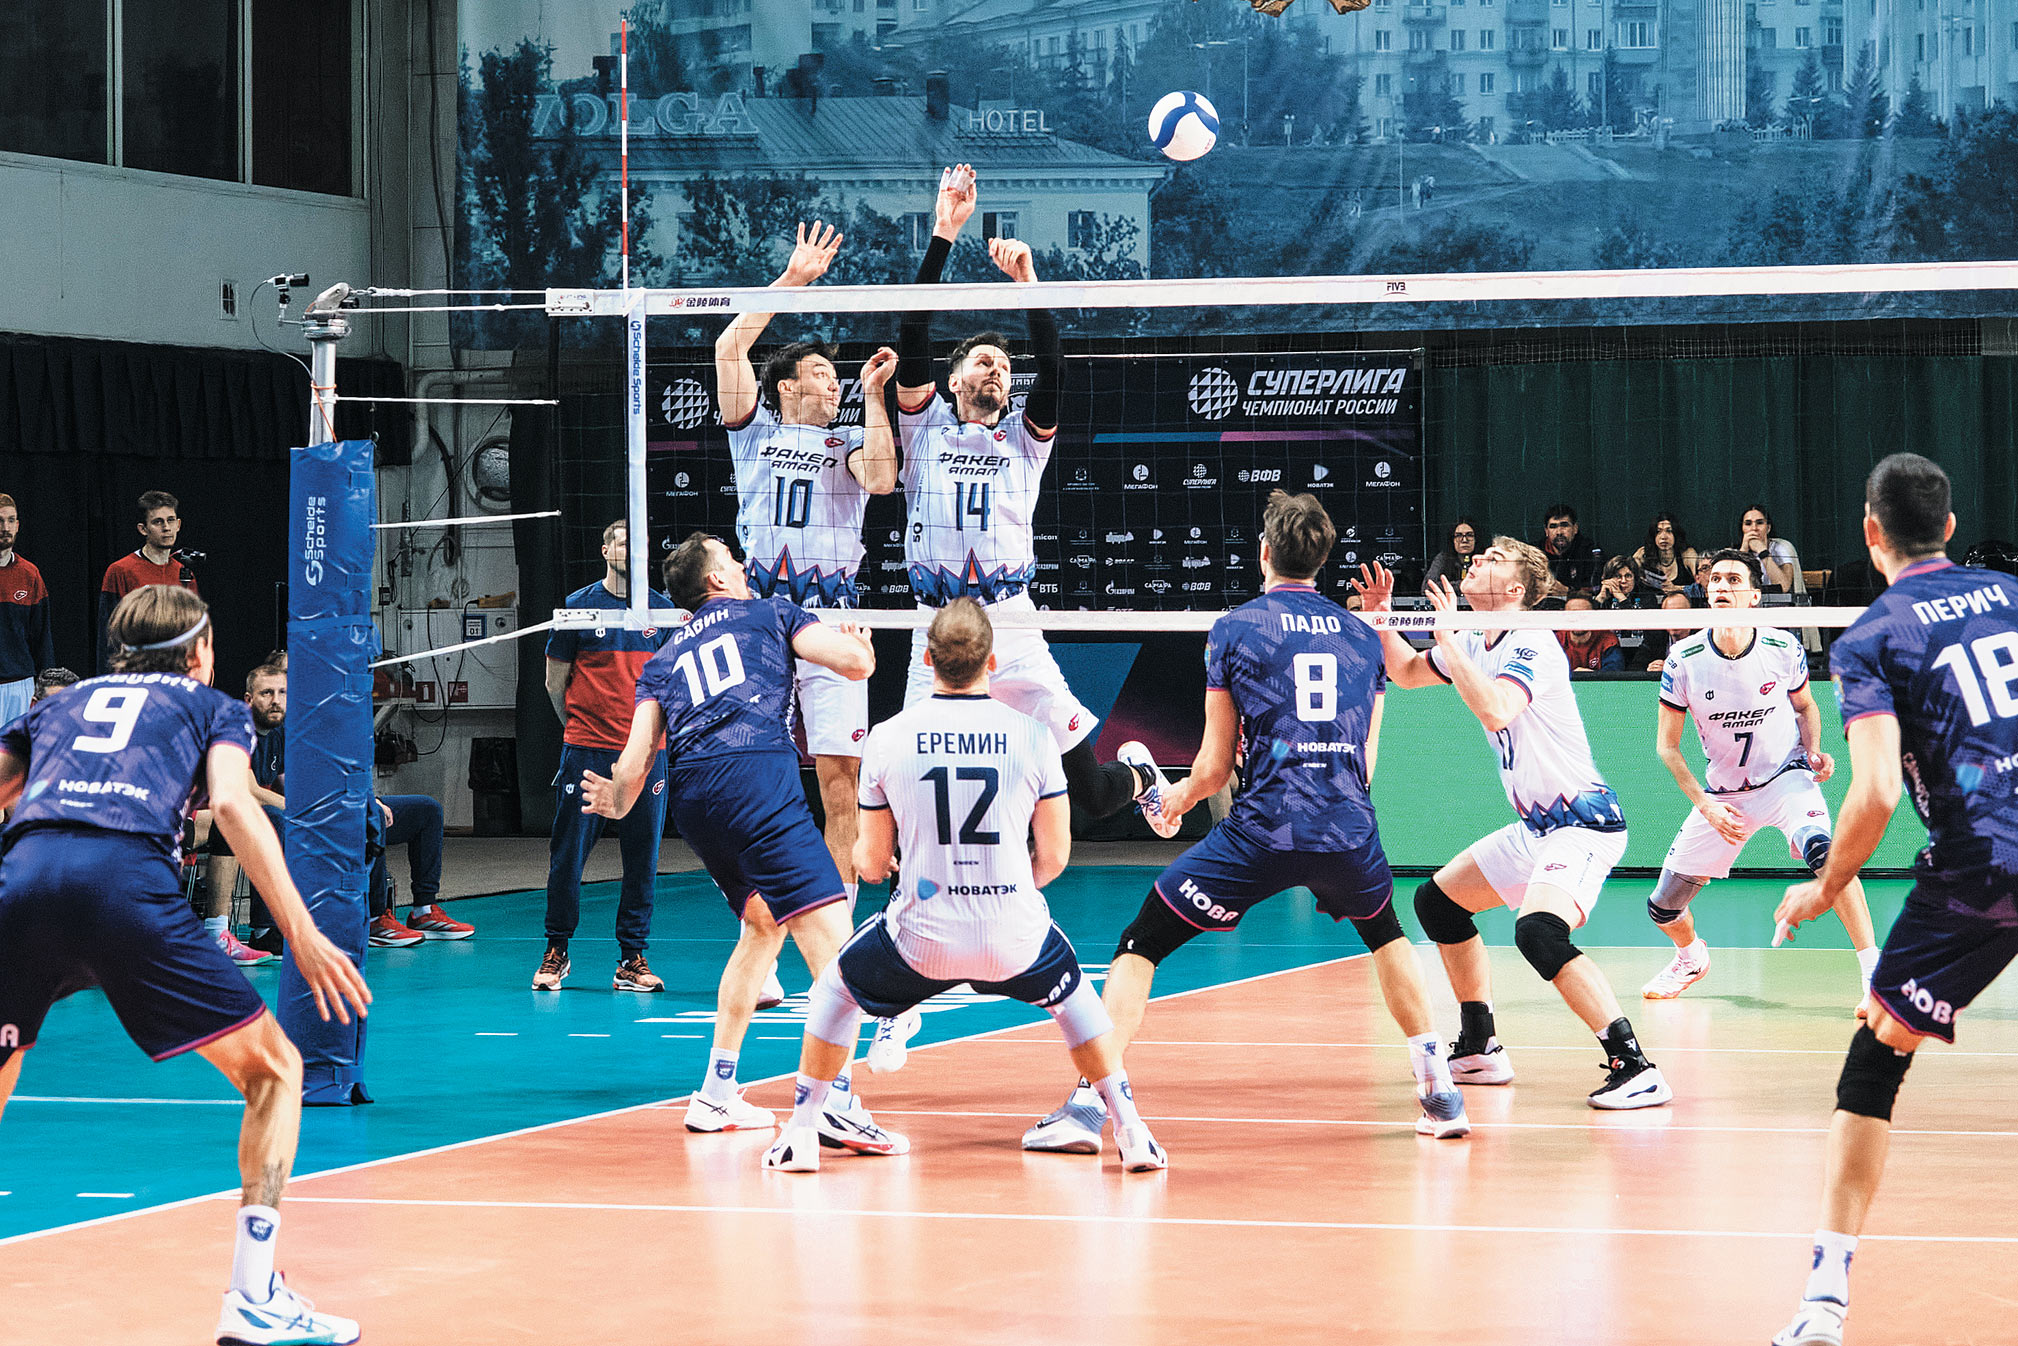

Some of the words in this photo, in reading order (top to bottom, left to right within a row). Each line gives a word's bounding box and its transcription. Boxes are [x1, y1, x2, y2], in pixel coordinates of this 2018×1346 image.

[969, 109, 1052, 132] HOTEL
[632, 331, 641, 376] Schelde
[631, 377, 641, 415] Sports
[1247, 368, 1407, 395] СУПЕРЛИГА
[1242, 400, 1334, 416] ЧЕМПИОНАТ
[1335, 399, 1398, 415] РОССИИ
[1250, 469, 1281, 482] ВФВ
[774, 476, 814, 529] 10
[955, 482, 990, 532] 14
[304, 496, 316, 560] Schelde
[313, 496, 327, 560] Sports
[889, 584, 909, 593] ВФВ
[1039, 583, 1058, 593] ВТБ
[1190, 582, 1211, 591] ВФВ
[1912, 584, 2010, 625] ПЕРИЧ
[674, 608, 729, 645] САВИН
[1280, 613, 1342, 635] ПАДО
[671, 632, 746, 708] 10
[1293, 653, 1338, 722] 8
[1930, 631, 2018, 727] 18
[72, 687, 150, 753] 9
[917, 732, 1007, 755] ЕРЕМИН
[1297, 742, 1357, 754] НОВАТЭК
[1733, 731, 1754, 768] 7
[58, 779, 150, 801] НОВАТЭК
[919, 766, 1000, 845] 12
[948, 884, 1018, 896] НОВАТЭК
[1178, 878, 1240, 923] НОВА
